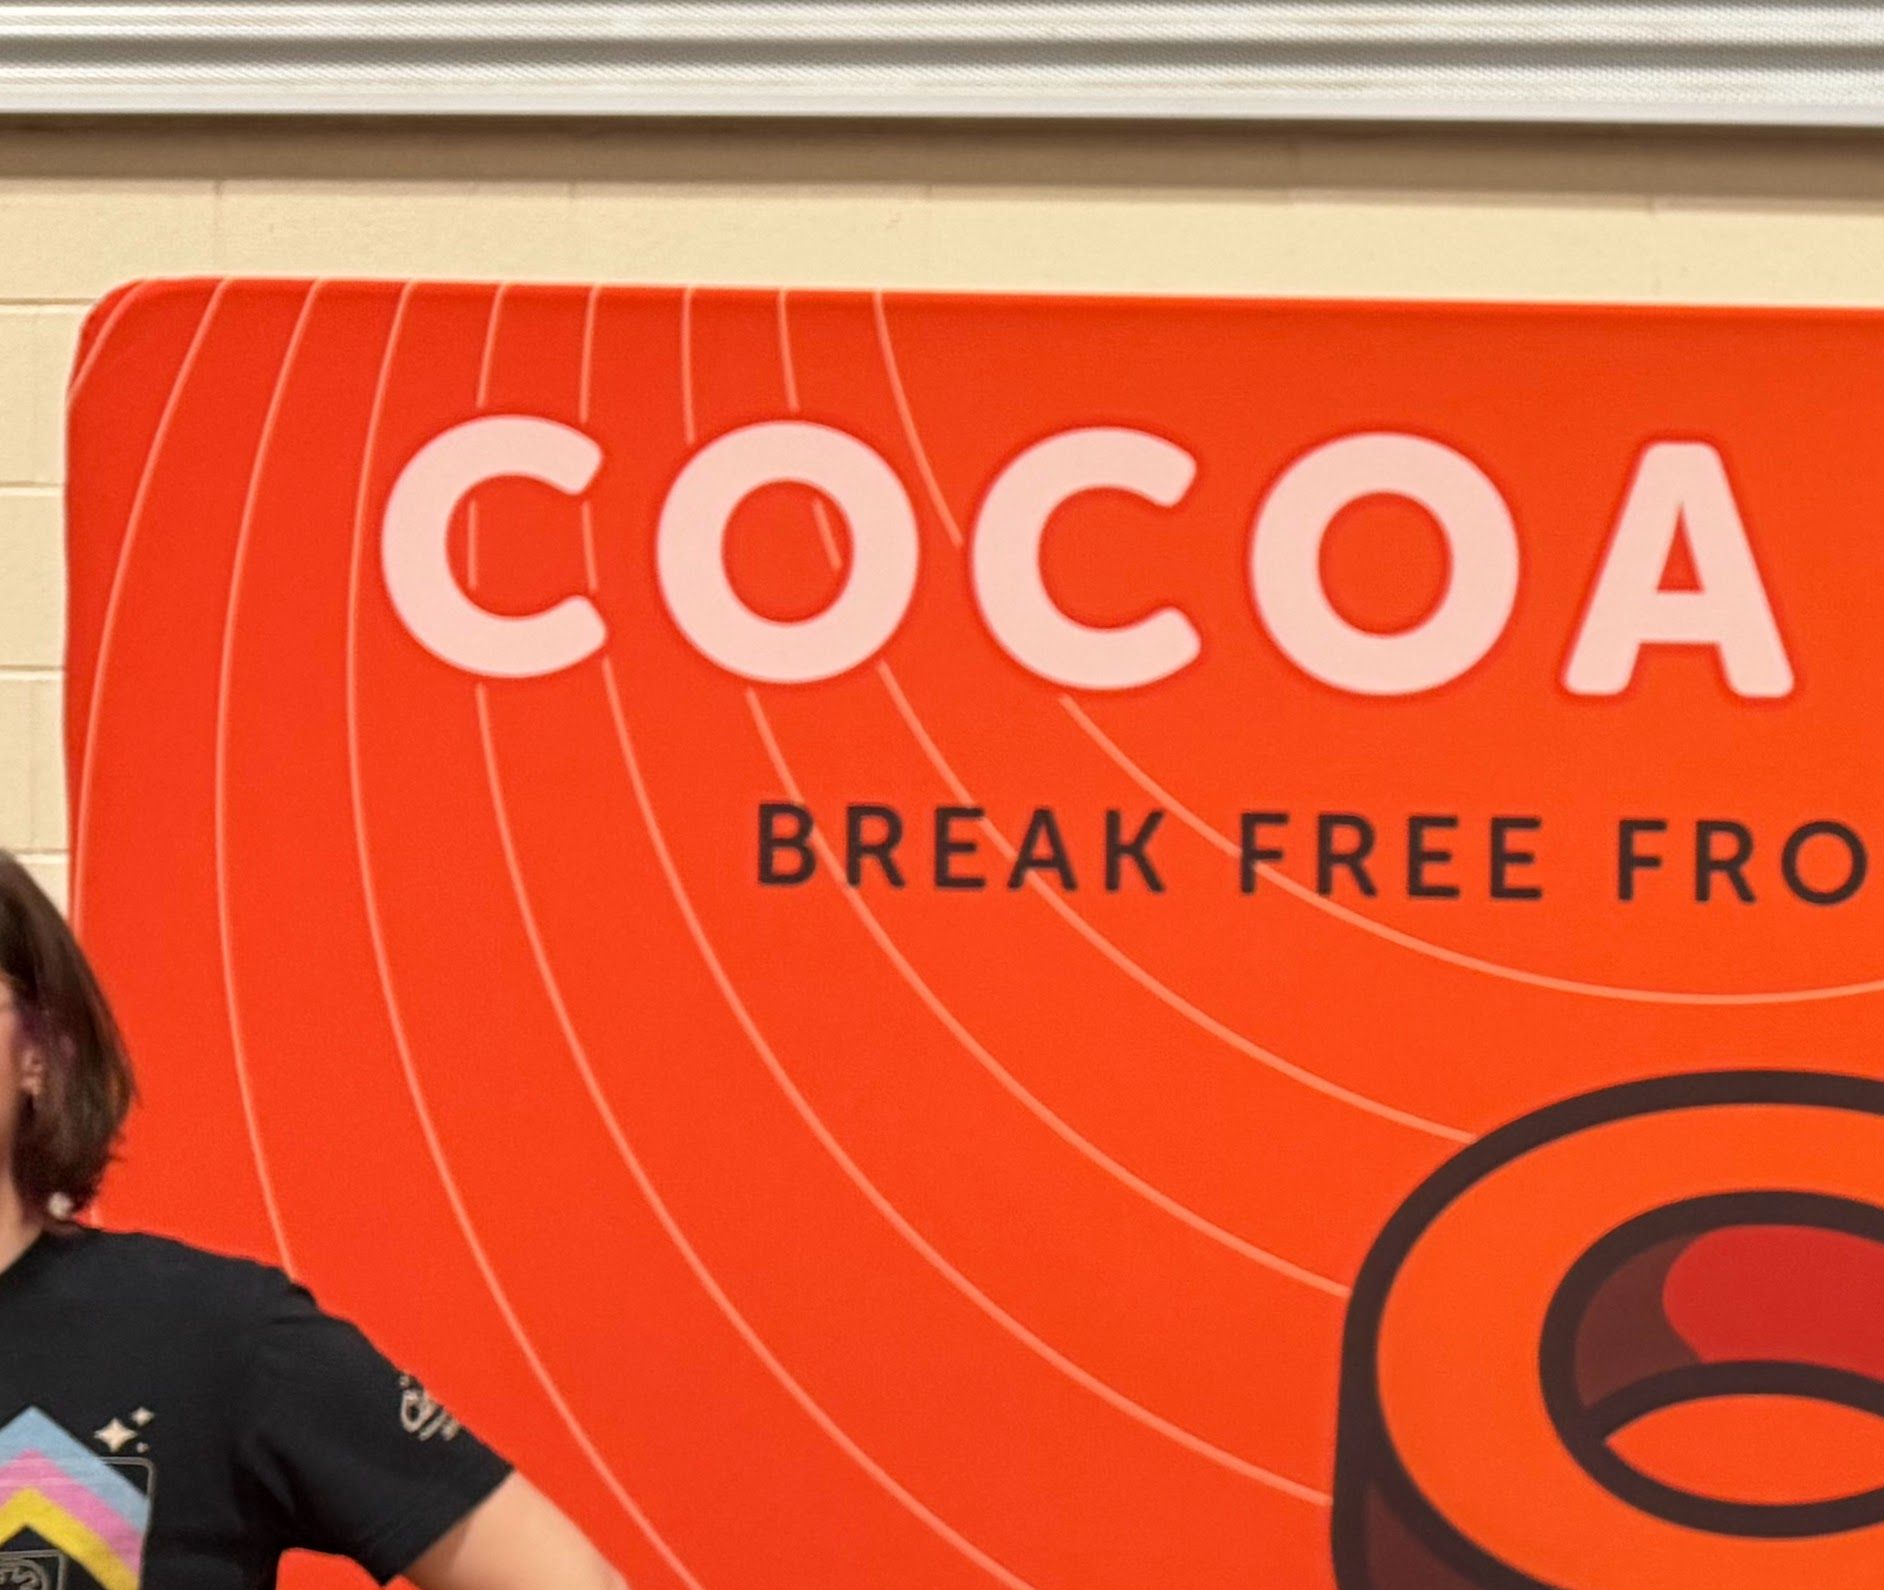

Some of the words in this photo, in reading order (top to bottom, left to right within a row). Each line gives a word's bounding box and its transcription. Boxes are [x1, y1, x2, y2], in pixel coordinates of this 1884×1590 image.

[381, 413, 1793, 698] COCOA
[757, 802, 1167, 894] BREAK
[1238, 810, 1544, 902] FREE
